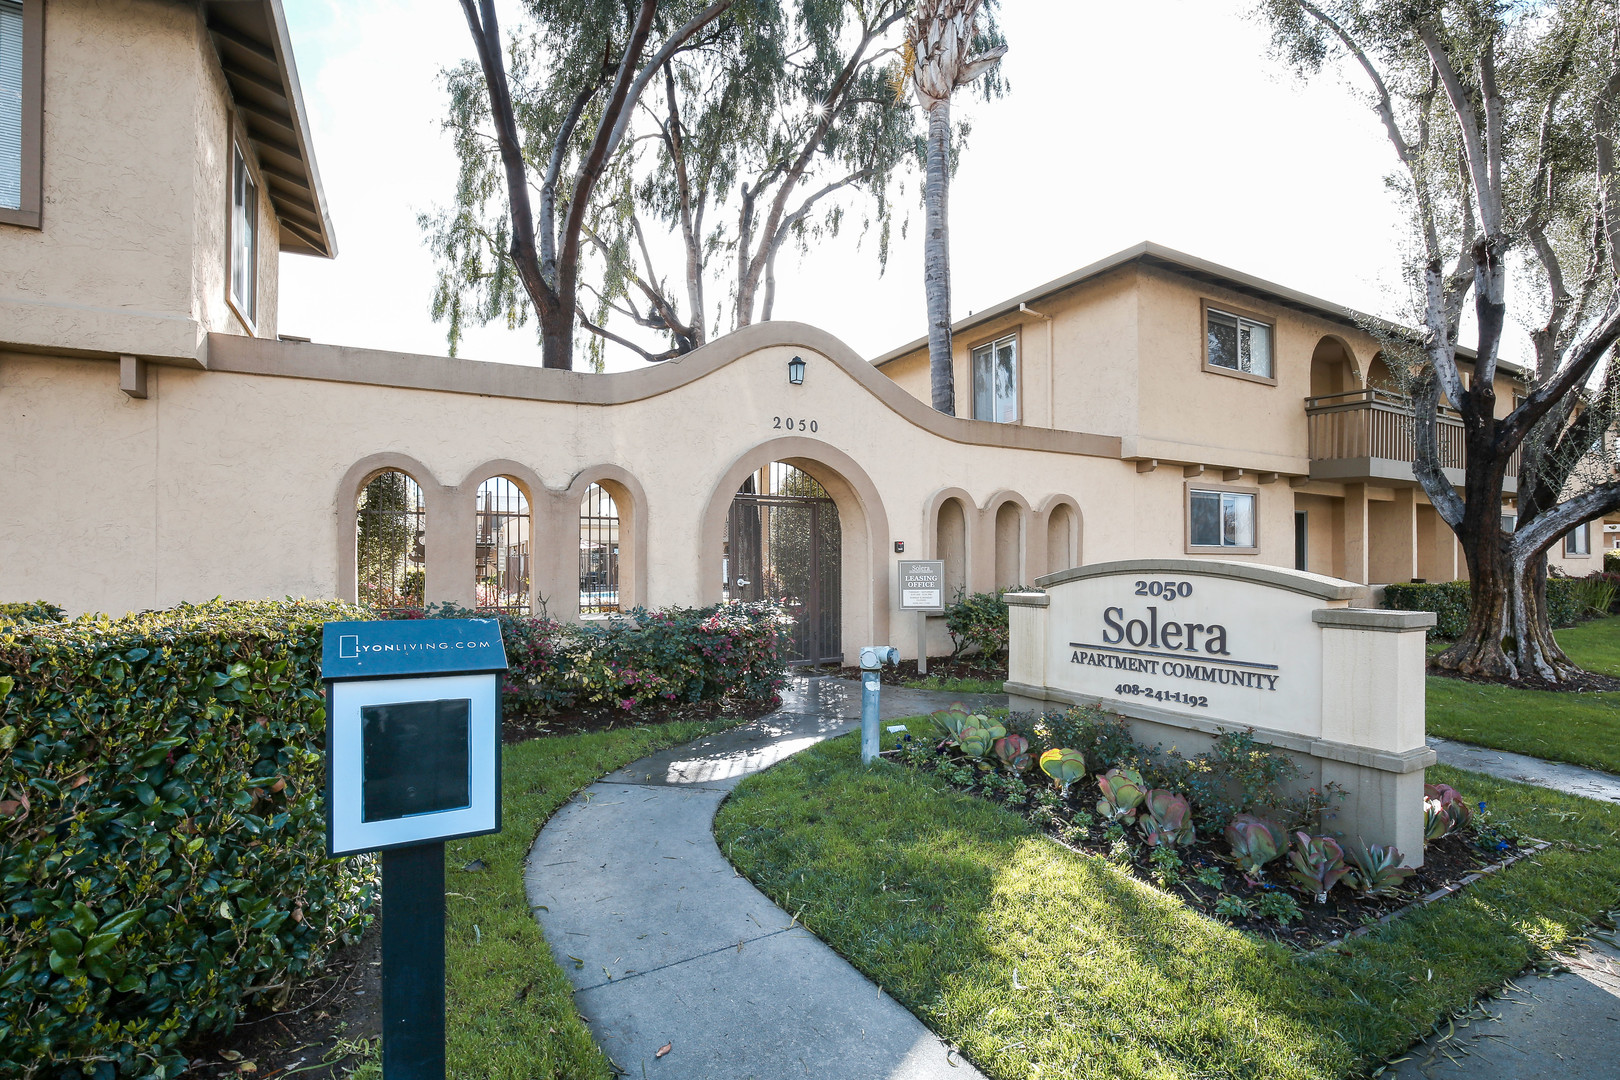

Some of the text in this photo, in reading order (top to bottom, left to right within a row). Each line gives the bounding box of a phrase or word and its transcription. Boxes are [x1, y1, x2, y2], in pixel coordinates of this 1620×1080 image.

[773, 416, 818, 433] 2050
[1134, 580, 1193, 601] 2050
[1102, 606, 1231, 656] Solera
[355, 640, 490, 653] LYONLIVING.COM
[1070, 650, 1279, 691] APARTMENT COMMUNITY
[1114, 683, 1209, 708] 408-241-1192
